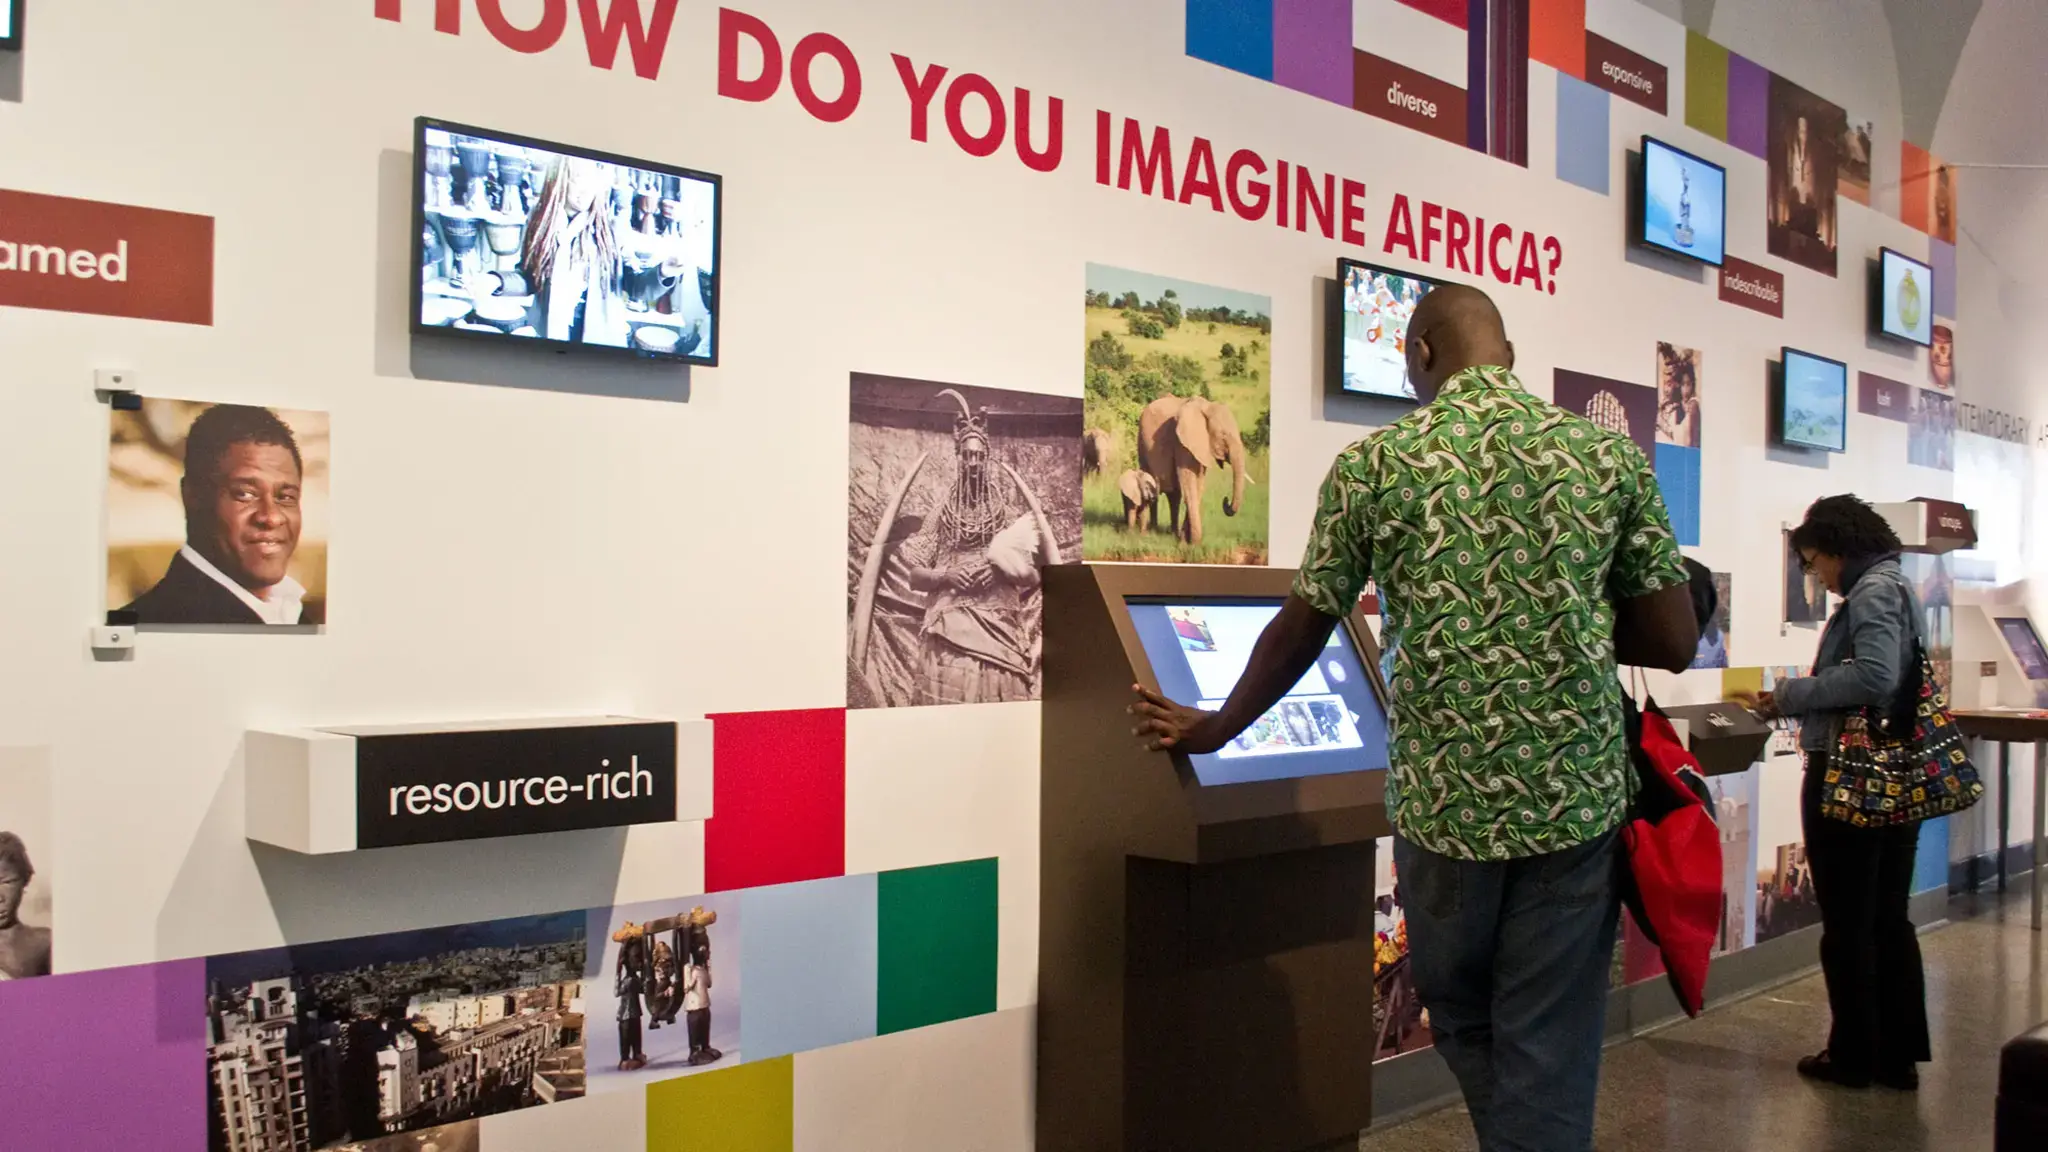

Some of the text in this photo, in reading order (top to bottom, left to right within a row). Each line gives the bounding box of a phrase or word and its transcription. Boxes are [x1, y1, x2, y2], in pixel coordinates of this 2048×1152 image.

[1602, 61, 1653, 95] expansive
[1387, 81, 1438, 118] diverse
[374, 0, 1563, 296] OW DO YOU IMAGINE AFRICA?
[1724, 270, 1779, 304] indescribable
[389, 754, 654, 816] resource-rich
